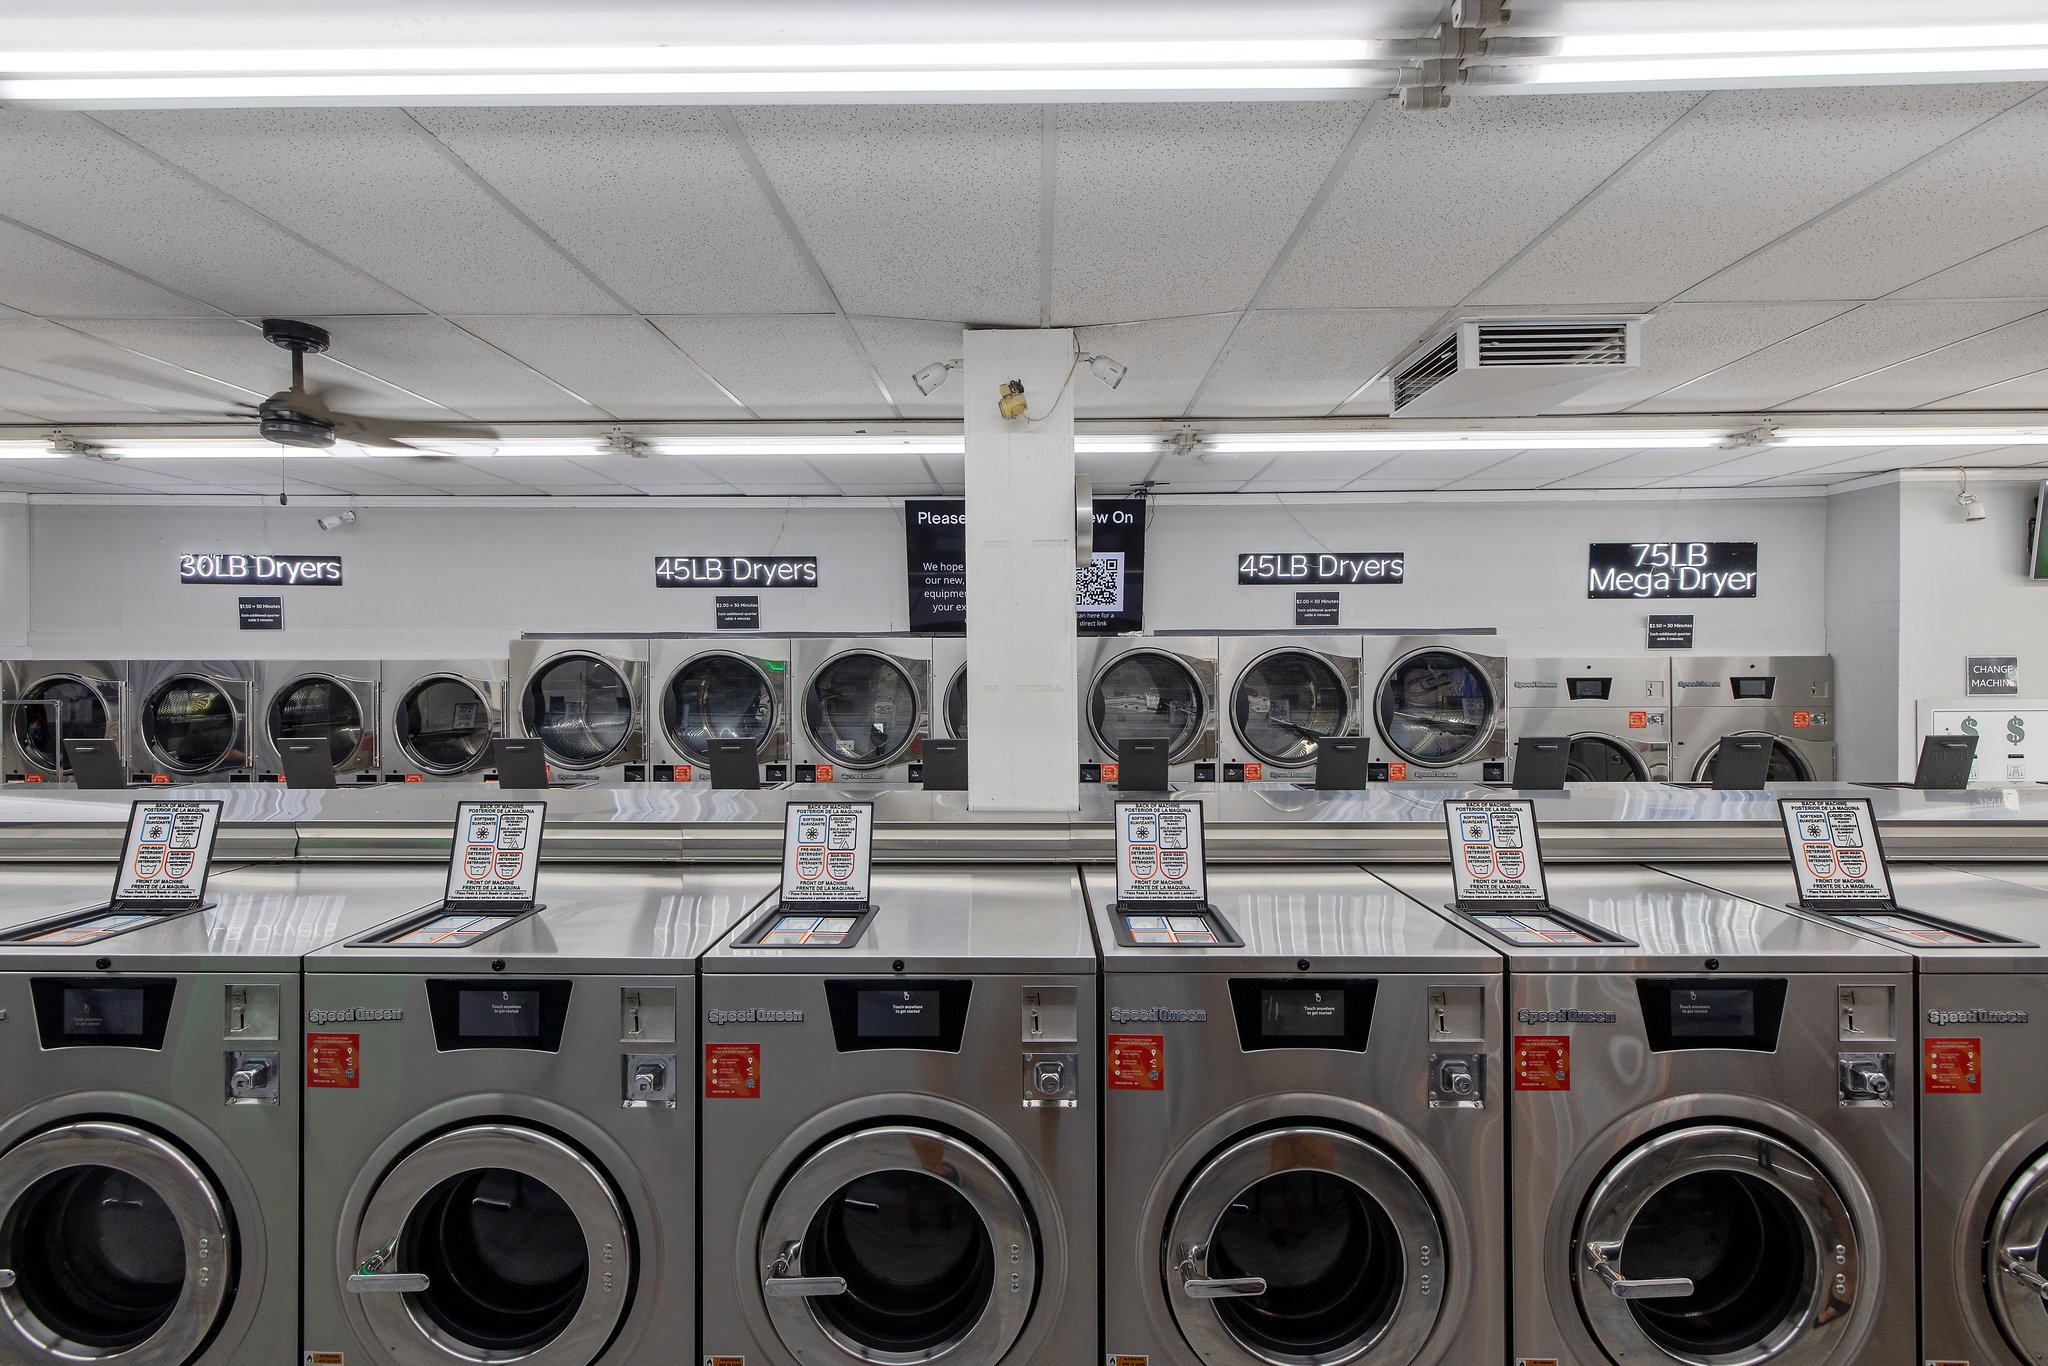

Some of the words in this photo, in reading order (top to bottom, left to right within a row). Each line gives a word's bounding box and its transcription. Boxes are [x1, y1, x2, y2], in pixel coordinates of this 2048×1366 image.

[918, 512, 966, 524] Please
[1112, 510, 1133, 524] On
[1632, 544, 1708, 566] 75LB
[180, 554, 246, 577] 30LB
[256, 556, 341, 584] Dryers
[656, 558, 722, 580] 45LB
[734, 558, 816, 586] Dryers
[923, 562, 938, 571] We
[940, 562, 964, 573] hope
[1240, 555, 1308, 576] 45LB
[1320, 555, 1403, 582] Dryers
[944, 578, 965, 586] new,
[1589, 568, 1670, 597] Mega
[1680, 566, 1757, 596] Dryer
[933, 604, 954, 613] your
[309, 1009, 354, 1025] Speed
[355, 1007, 402, 1021] Queen
[708, 1008, 756, 1025] Speed
[757, 1008, 803, 1022] Queen
[1110, 1007, 1159, 1024] Speed
[1519, 1008, 1567, 1025] Speed
[1568, 1008, 1616, 1023] Queen
[1928, 1008, 1978, 1026] Speed
